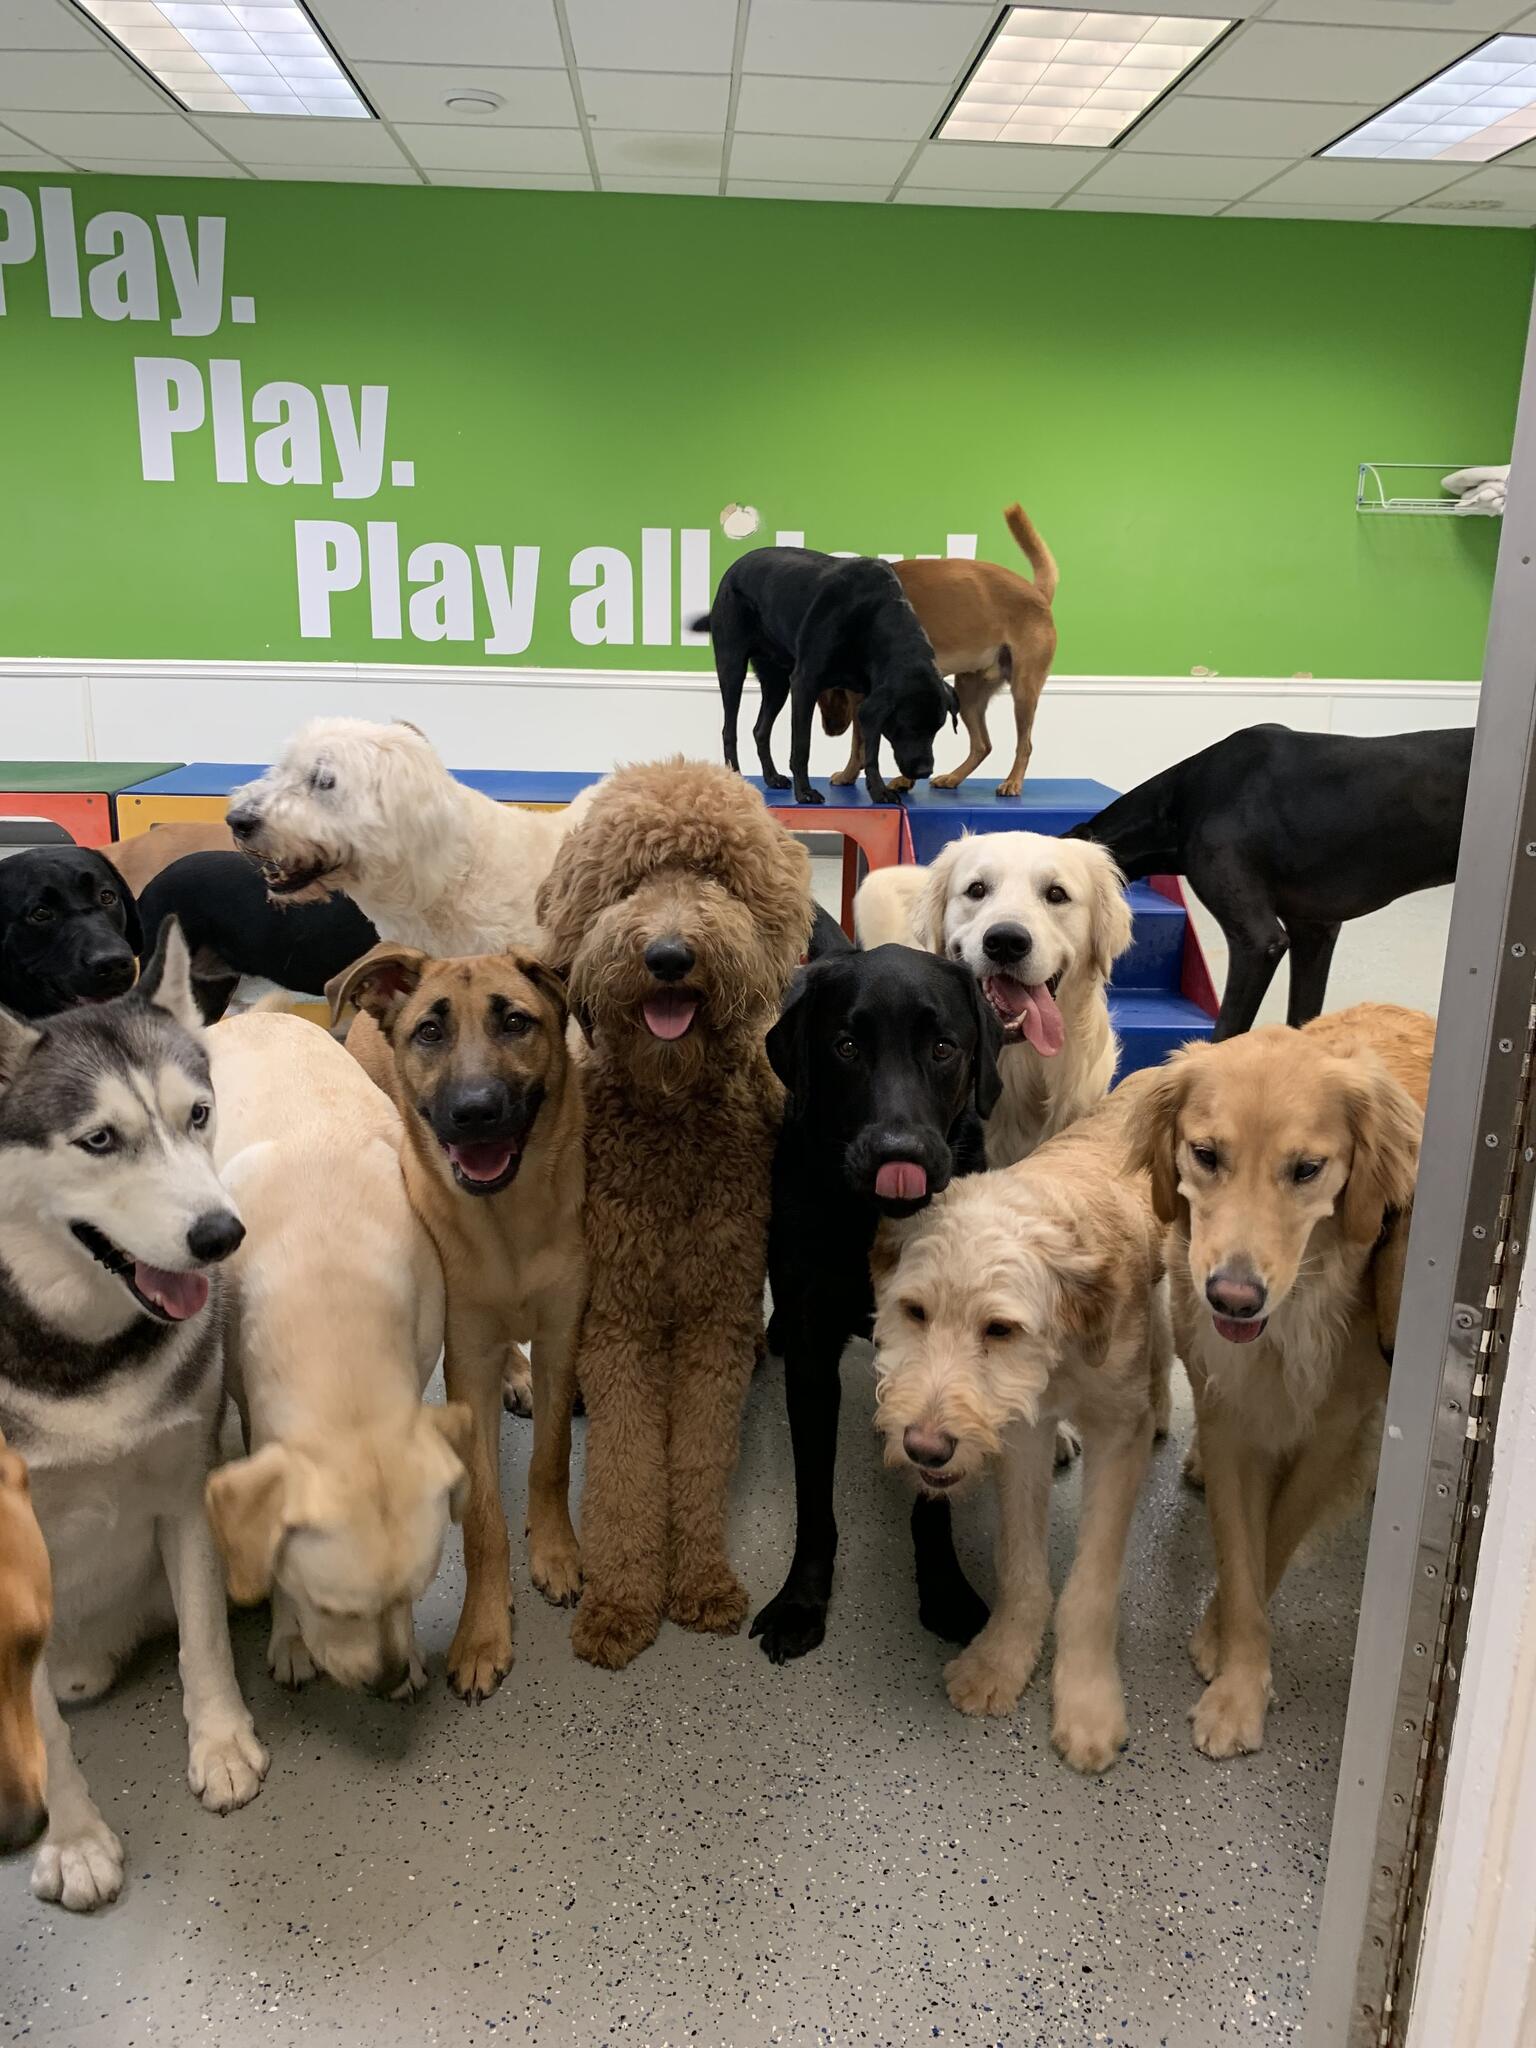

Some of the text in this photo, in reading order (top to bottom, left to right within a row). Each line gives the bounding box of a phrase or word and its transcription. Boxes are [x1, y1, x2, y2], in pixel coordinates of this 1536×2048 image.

[134, 356, 416, 500] Play.
[294, 518, 712, 656] Play all
